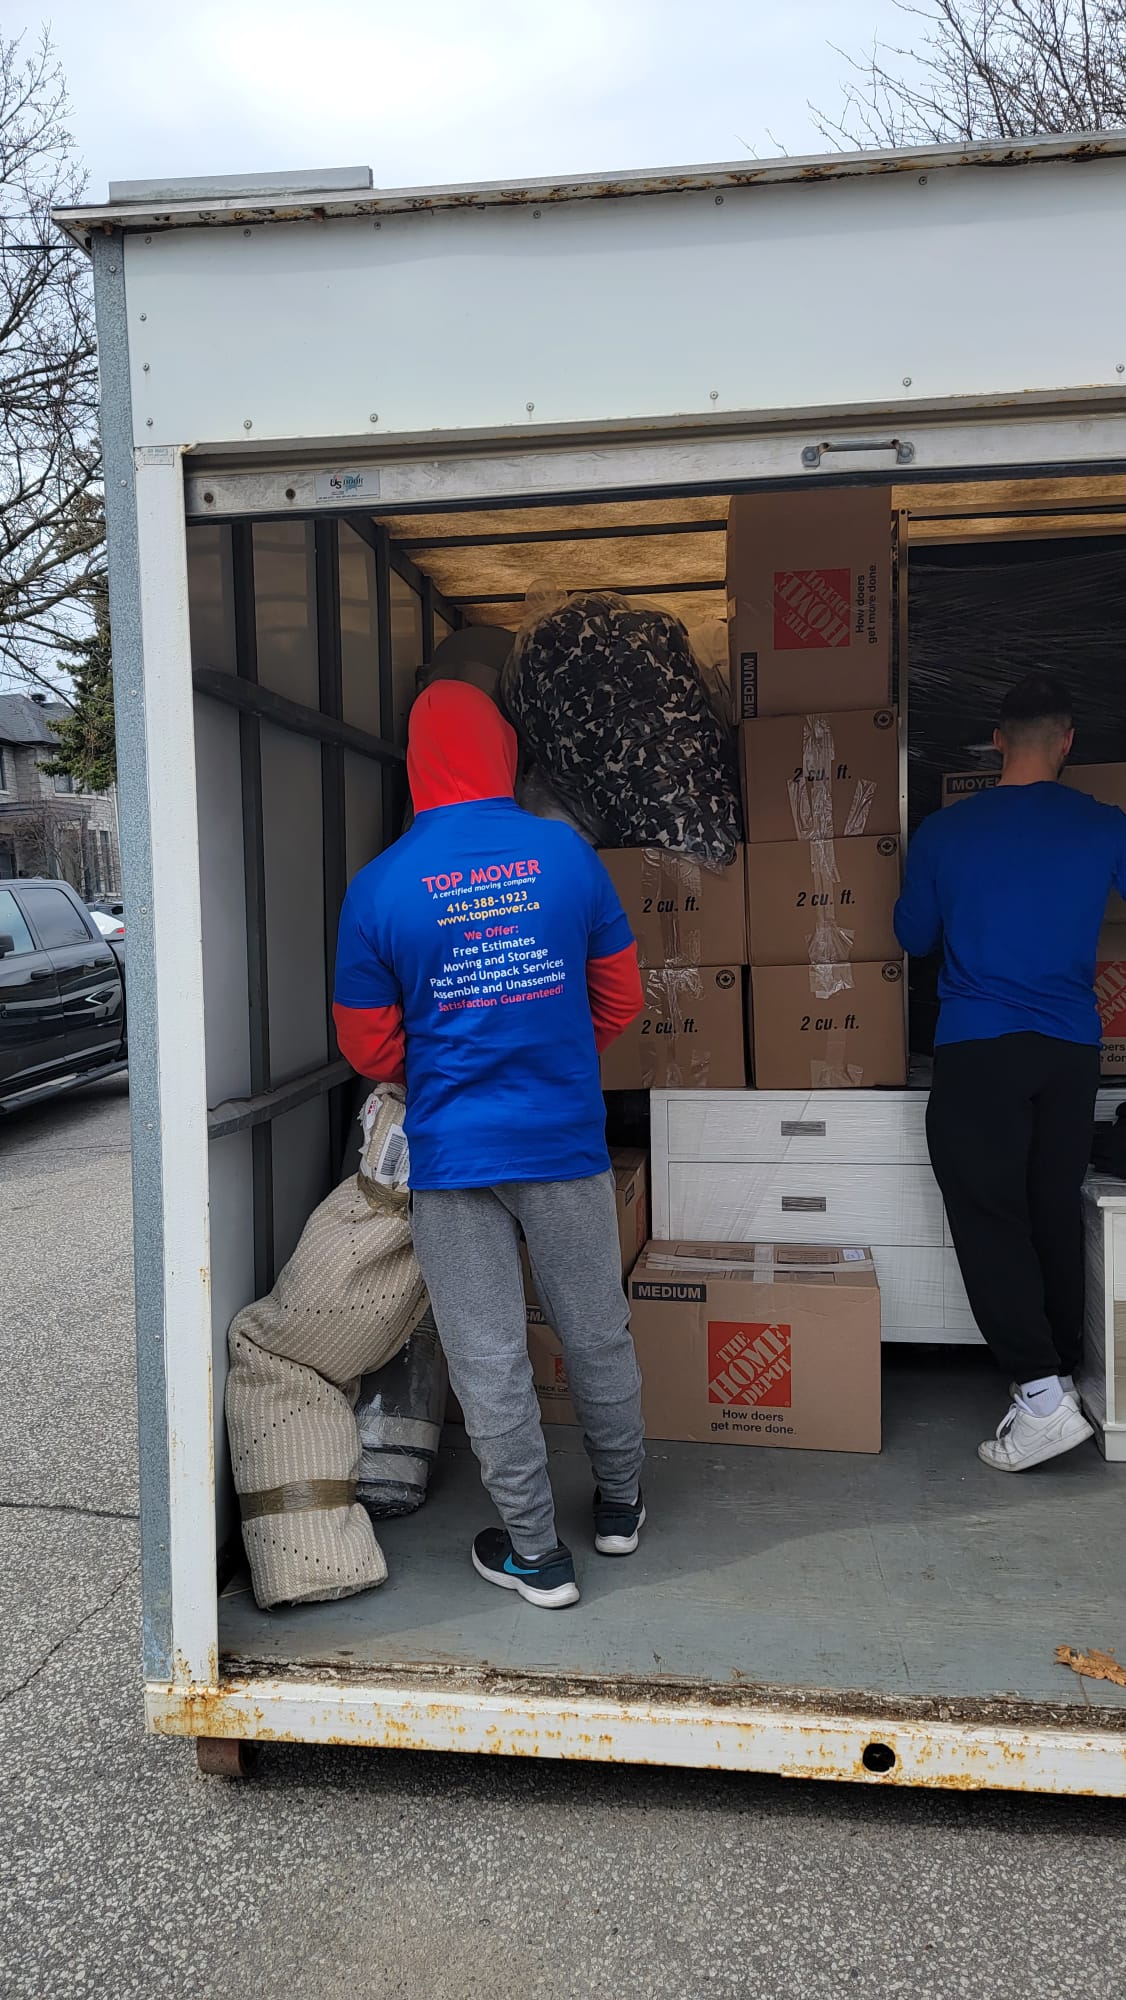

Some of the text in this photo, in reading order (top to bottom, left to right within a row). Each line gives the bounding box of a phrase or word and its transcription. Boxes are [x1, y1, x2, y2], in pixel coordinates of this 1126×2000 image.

[802, 570, 850, 617] DEPOT
[856, 575, 865, 633] How doers
[775, 572, 849, 646] HOME
[868, 595, 877, 624] more
[782, 608, 813, 641] THE
[867, 626, 878, 644] get
[743, 658, 755, 717] MEDIUM
[793, 764, 852, 783] 2 cu. ft.
[952, 777, 999, 790] MOYE
[421, 859, 542, 893] TOP MOVER
[439, 886, 473, 899] certified
[474, 882, 502, 892] moving
[503, 876, 537, 888] company
[447, 890, 528, 913] 416-388-1923
[642, 896, 700, 913] 2 cu. ft.
[796, 889, 856, 907] 2 cu. ft.
[437, 901, 541, 927] www.topmover.ca
[464, 924, 519, 942] We Offer:
[452, 935, 536, 958] Free Estimates
[429, 958, 564, 988] Pack and Unpack Services
[443, 947, 549, 973] Moving and Storage
[433, 971, 566, 999] Assemble and Unassemble
[438, 984, 564, 1012] Satisfaction Guaranteed!
[641, 1018, 698, 1034] 2 cu. ft.
[800, 1014, 860, 1031] 2 cu. ft.
[638, 1284, 701, 1299] MEDIUM
[716, 1331, 751, 1362] THE
[708, 1324, 791, 1404] HOME
[741, 1355, 791, 1406] DEPOT
[722, 1408, 784, 1422] How doers
[711, 1422, 797, 1435] get more done.
